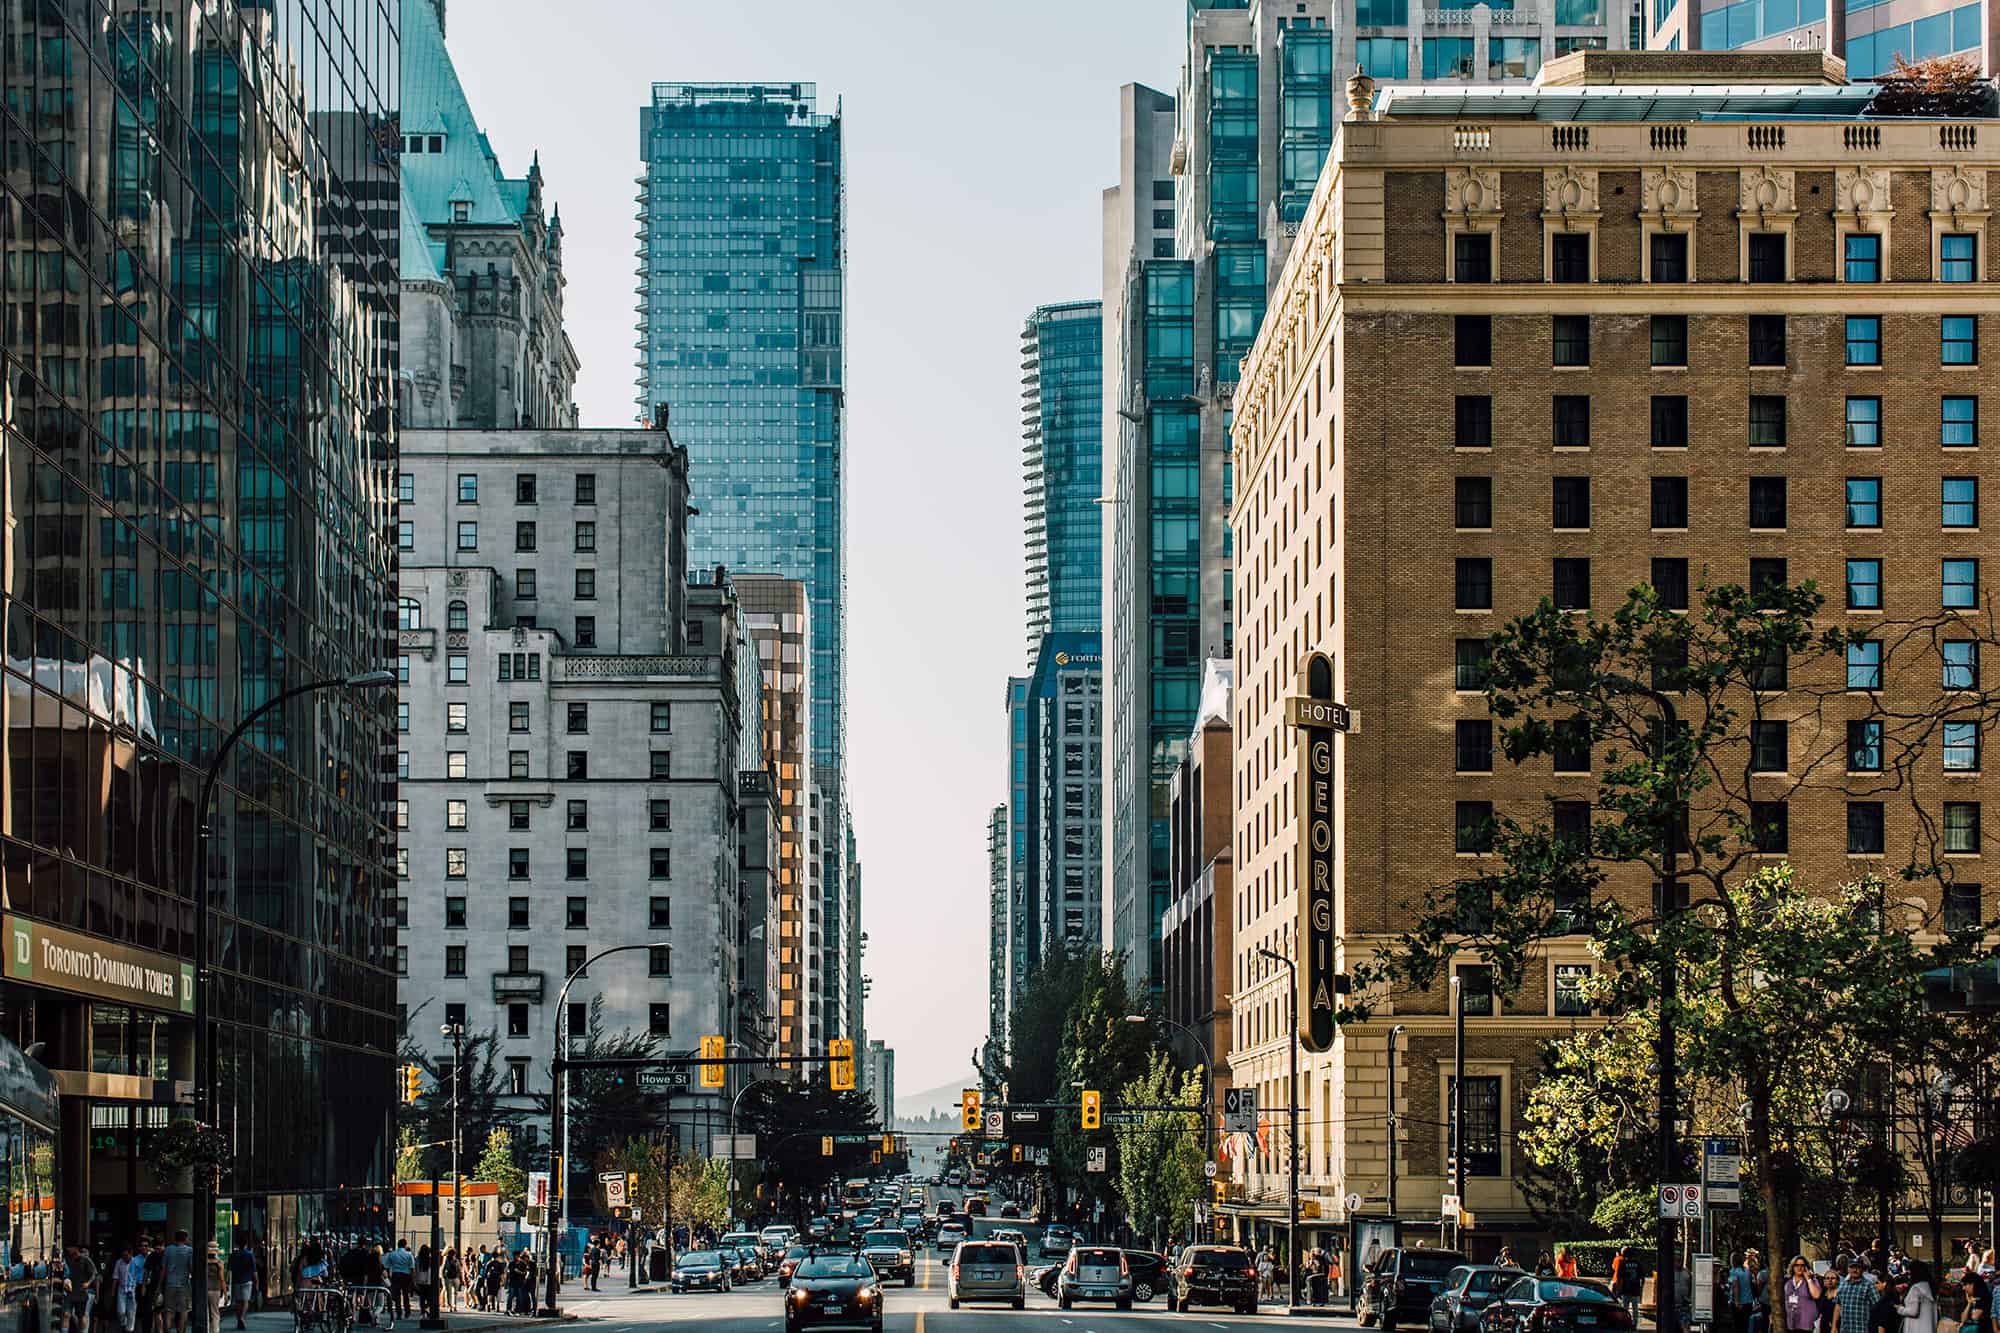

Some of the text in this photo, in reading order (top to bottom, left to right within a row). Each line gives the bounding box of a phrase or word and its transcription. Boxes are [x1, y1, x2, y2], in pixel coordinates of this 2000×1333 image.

[1301, 703, 1345, 725] HOTEL
[1311, 741, 1332, 1011] GEORGIA
[14, 930, 30, 964] TD
[41, 937, 174, 998] TORONTO DOMINION TOWER
[181, 973, 193, 1001] TD
[641, 1074, 687, 1084] Howe St
[1106, 1115, 1131, 1123] Howe
